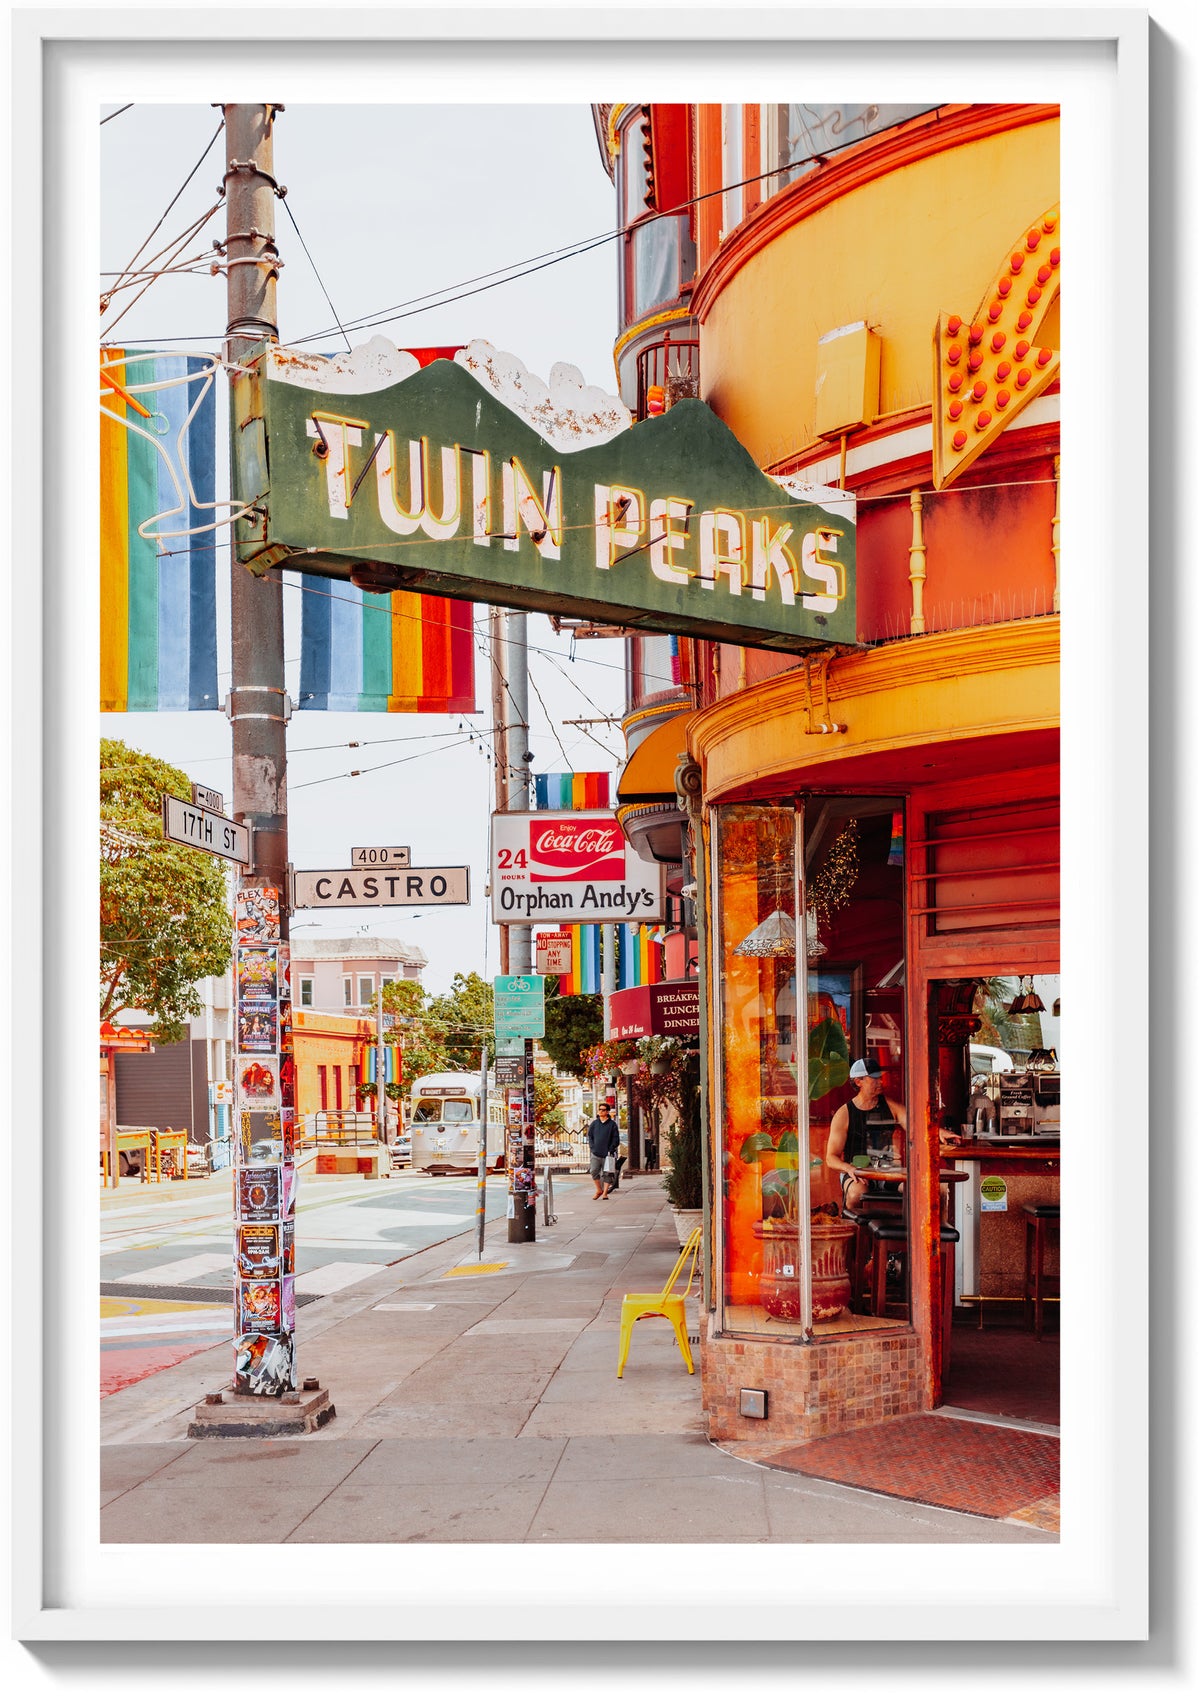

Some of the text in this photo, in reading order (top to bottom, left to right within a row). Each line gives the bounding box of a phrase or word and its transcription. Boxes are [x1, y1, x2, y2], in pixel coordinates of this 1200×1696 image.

[305, 411, 847, 614] TWIN PEAKS
[204, 790, 220, 811] 4000
[182, 810, 238, 851] 17TH ST
[559, 824, 577, 832] Enjoy
[536, 828, 618, 854] Coca-Cola
[358, 849, 389, 864] 400
[497, 848, 529, 870] 24
[237, 889, 261, 902] FLEX
[315, 875, 448, 900] CASTRO
[500, 884, 655, 917] Orphan Andy's
[537, 939, 571, 950] NO STOPPING
[547, 950, 561, 958] ANY
[546, 958, 562, 966] TIME
